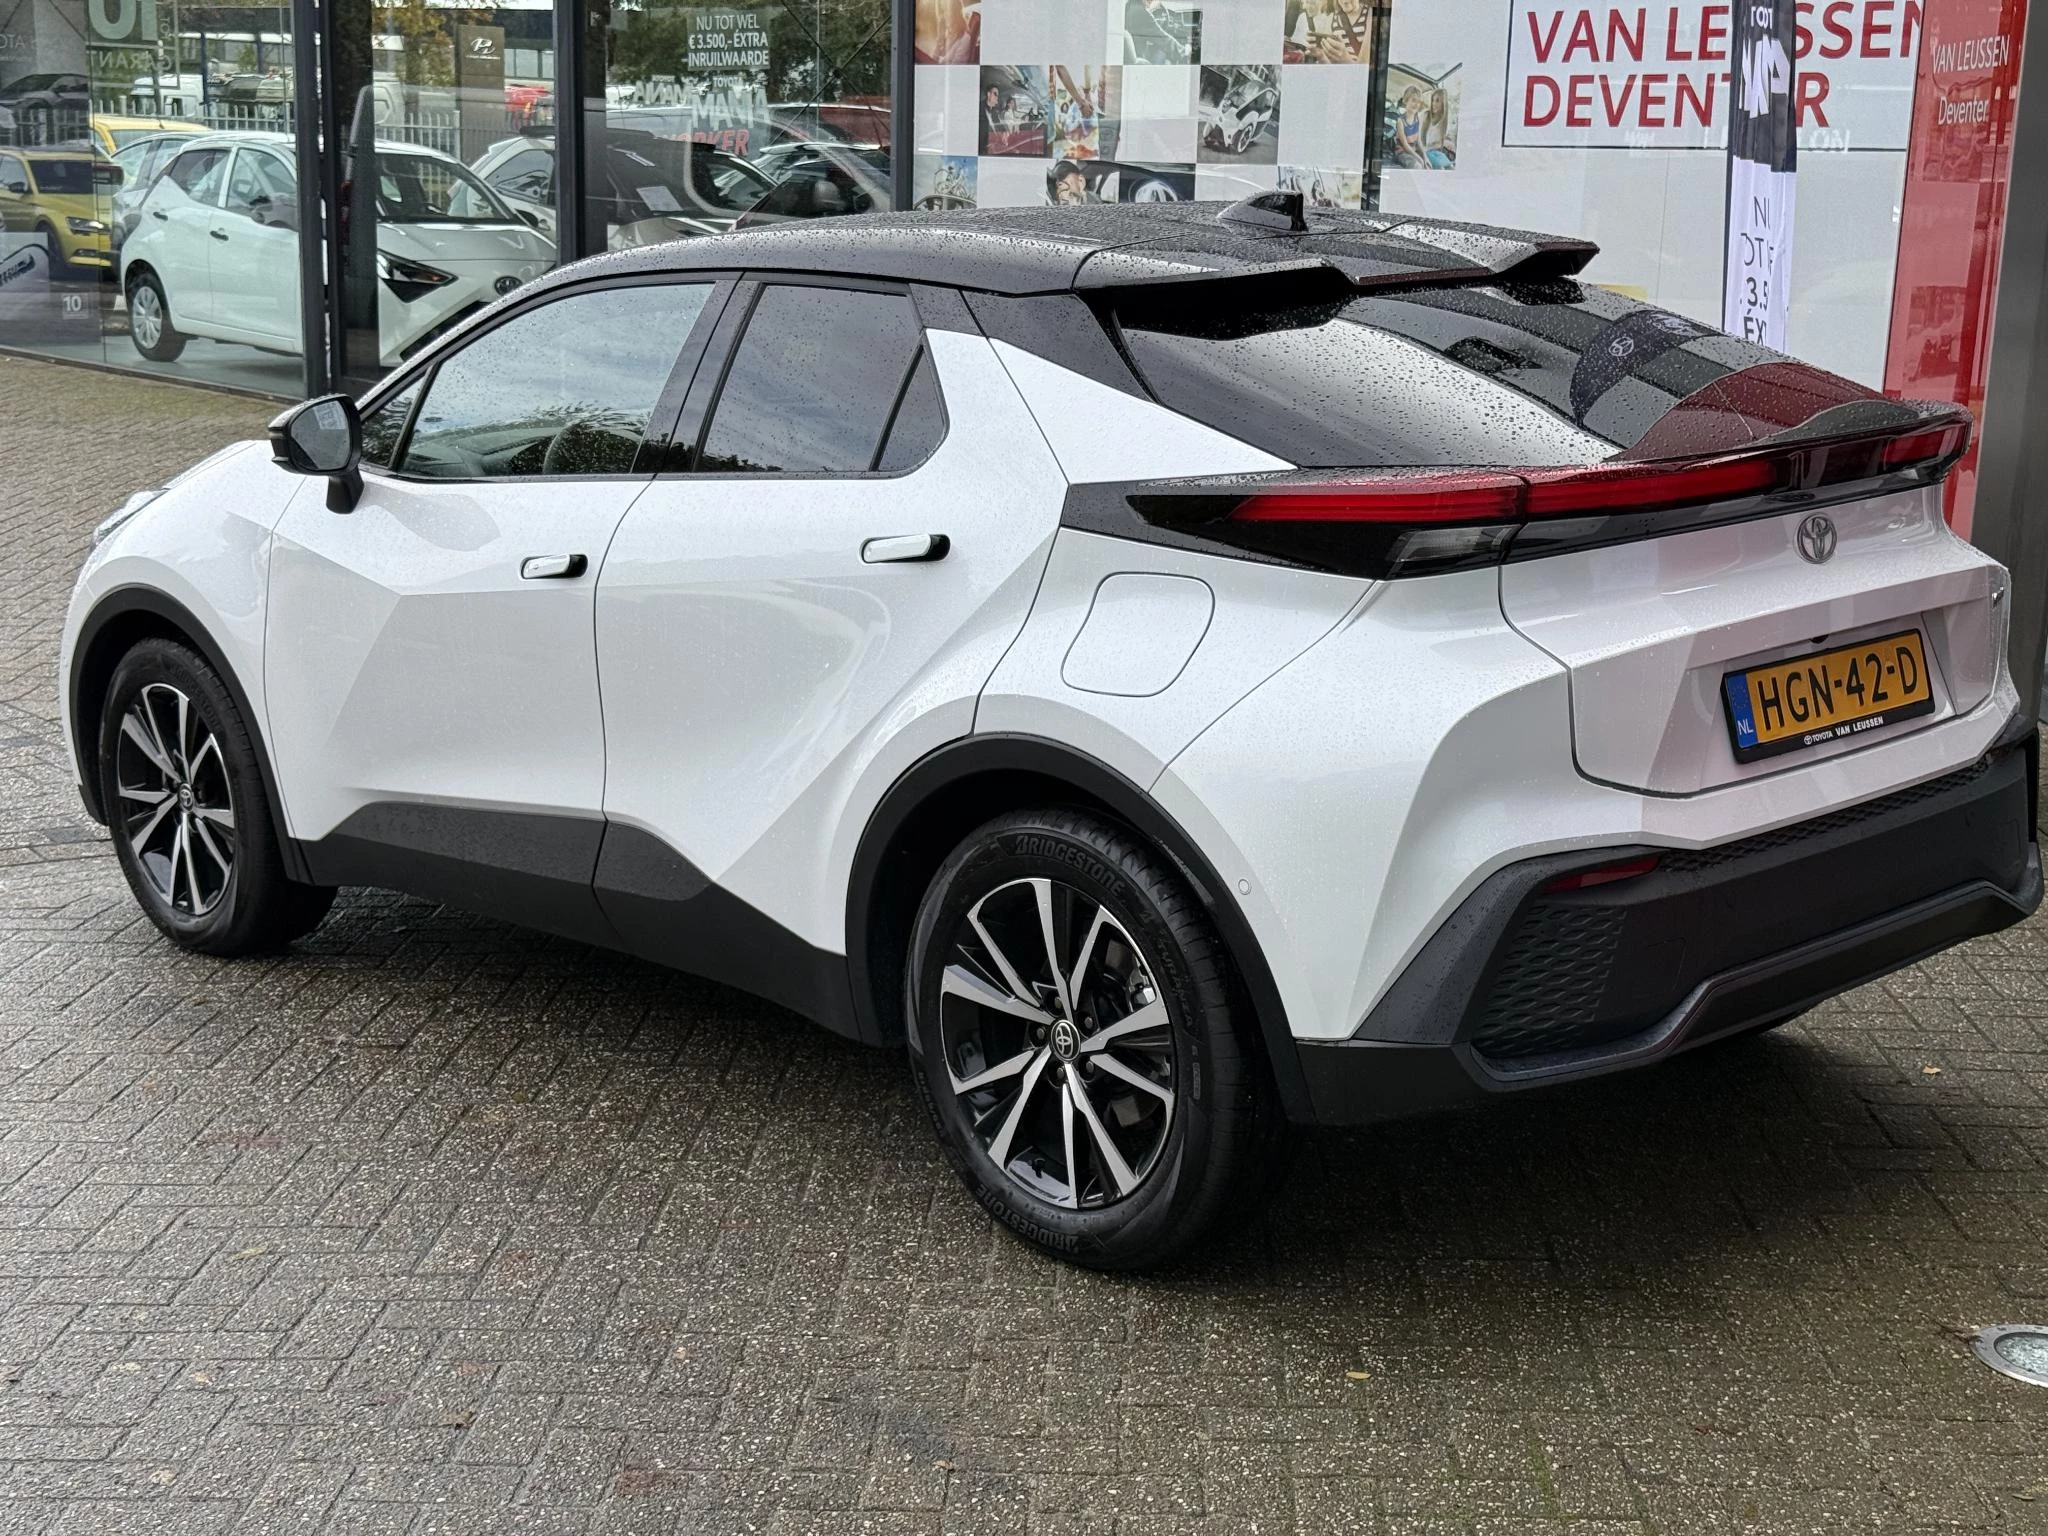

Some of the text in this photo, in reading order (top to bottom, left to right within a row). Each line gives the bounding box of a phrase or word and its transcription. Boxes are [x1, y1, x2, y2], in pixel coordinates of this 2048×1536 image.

[689, 29, 768, 50] € 3.500,- ÉXTRA
[696, 14, 760, 30] NU TOT WEL
[1527, 8, 1647, 63] VAN
[688, 50, 769, 67] INRUILWAARDE
[1933, 34, 2010, 74] VAN LEUSSEN
[691, 86, 770, 131] MANIA
[1524, 72, 1829, 128] DEVENR
[1938, 95, 1990, 125] Deventer
[63, 295, 82, 312] 10
[1757, 646, 1918, 731] HGN-42-D
[1737, 720, 1754, 735] NL
[1812, 716, 1884, 743] TOYOTA VAN LEUSSEN
[1015, 834, 1127, 897] BRIDGESTONE
[976, 1182, 1080, 1254] BRIDGESTONE
